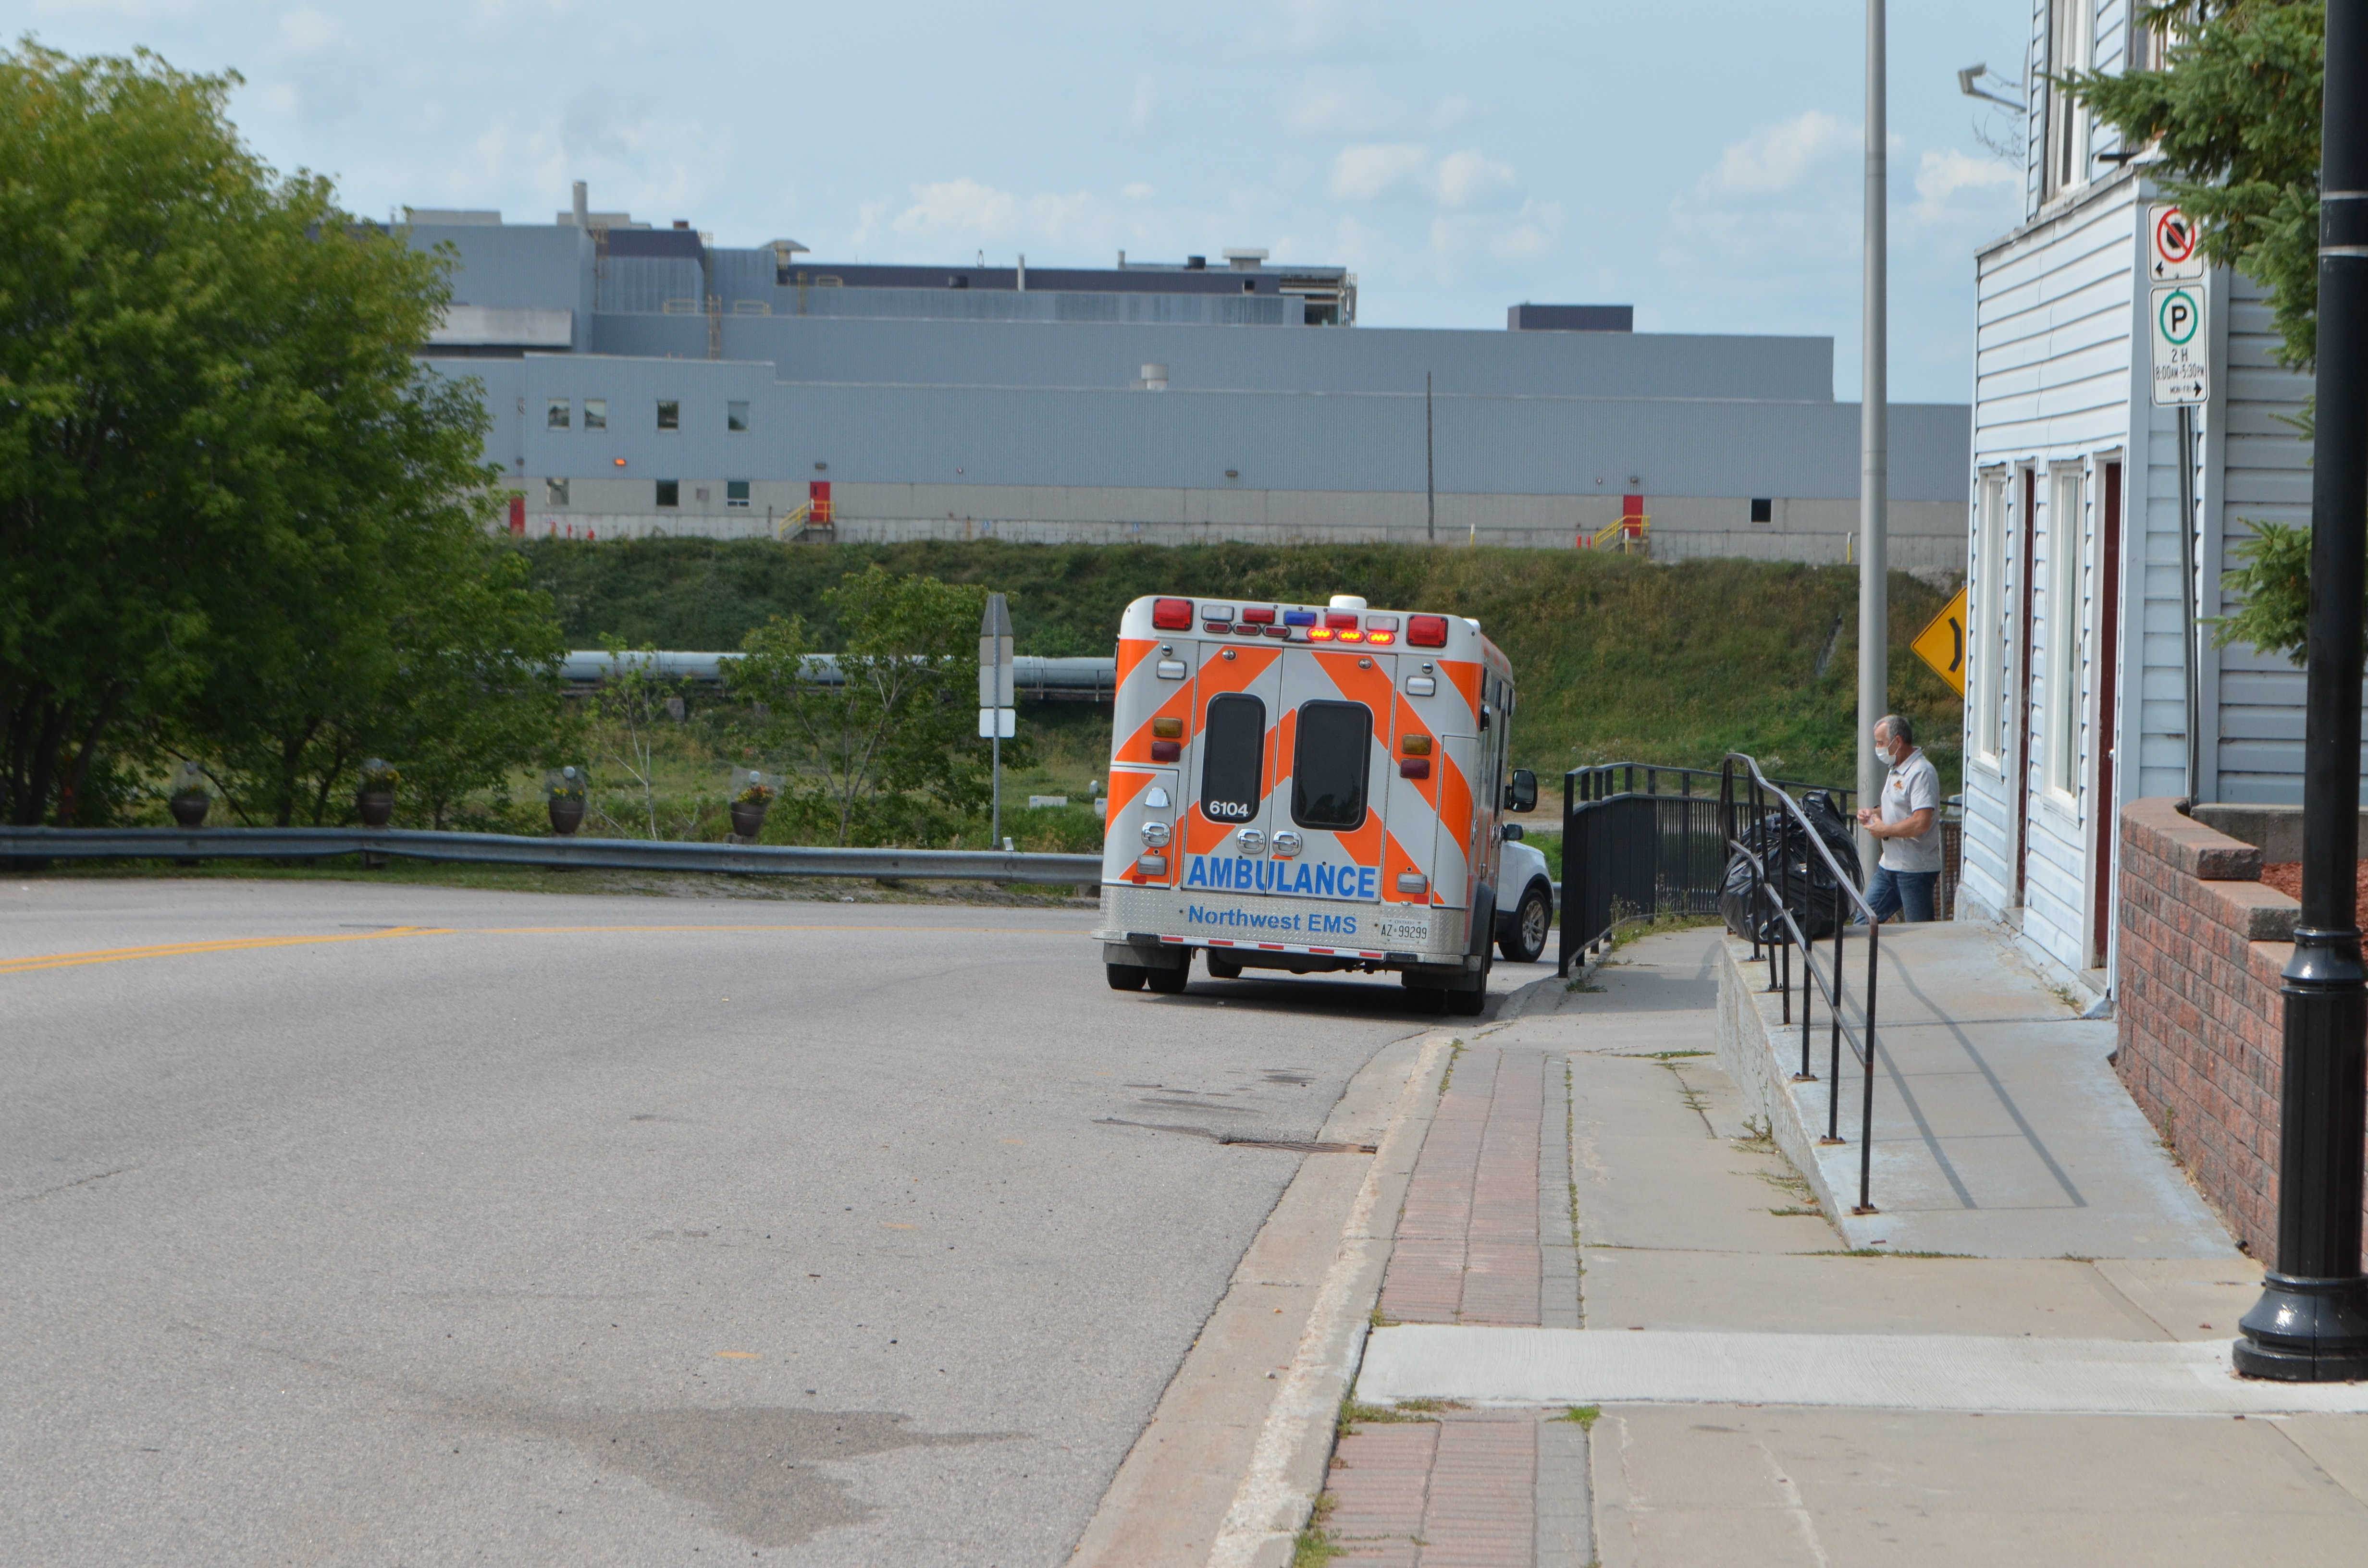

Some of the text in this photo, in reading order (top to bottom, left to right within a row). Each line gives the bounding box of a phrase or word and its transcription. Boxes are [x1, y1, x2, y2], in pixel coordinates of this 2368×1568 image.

[2172, 306, 2187, 332] P
[2171, 347, 2187, 363] 2 H
[1210, 801, 1248, 817] 6104
[1187, 856, 1375, 898] AMBULANCE
[1189, 906, 1357, 934] Northwest EMS
[1381, 924, 1427, 939] AZ 99299
